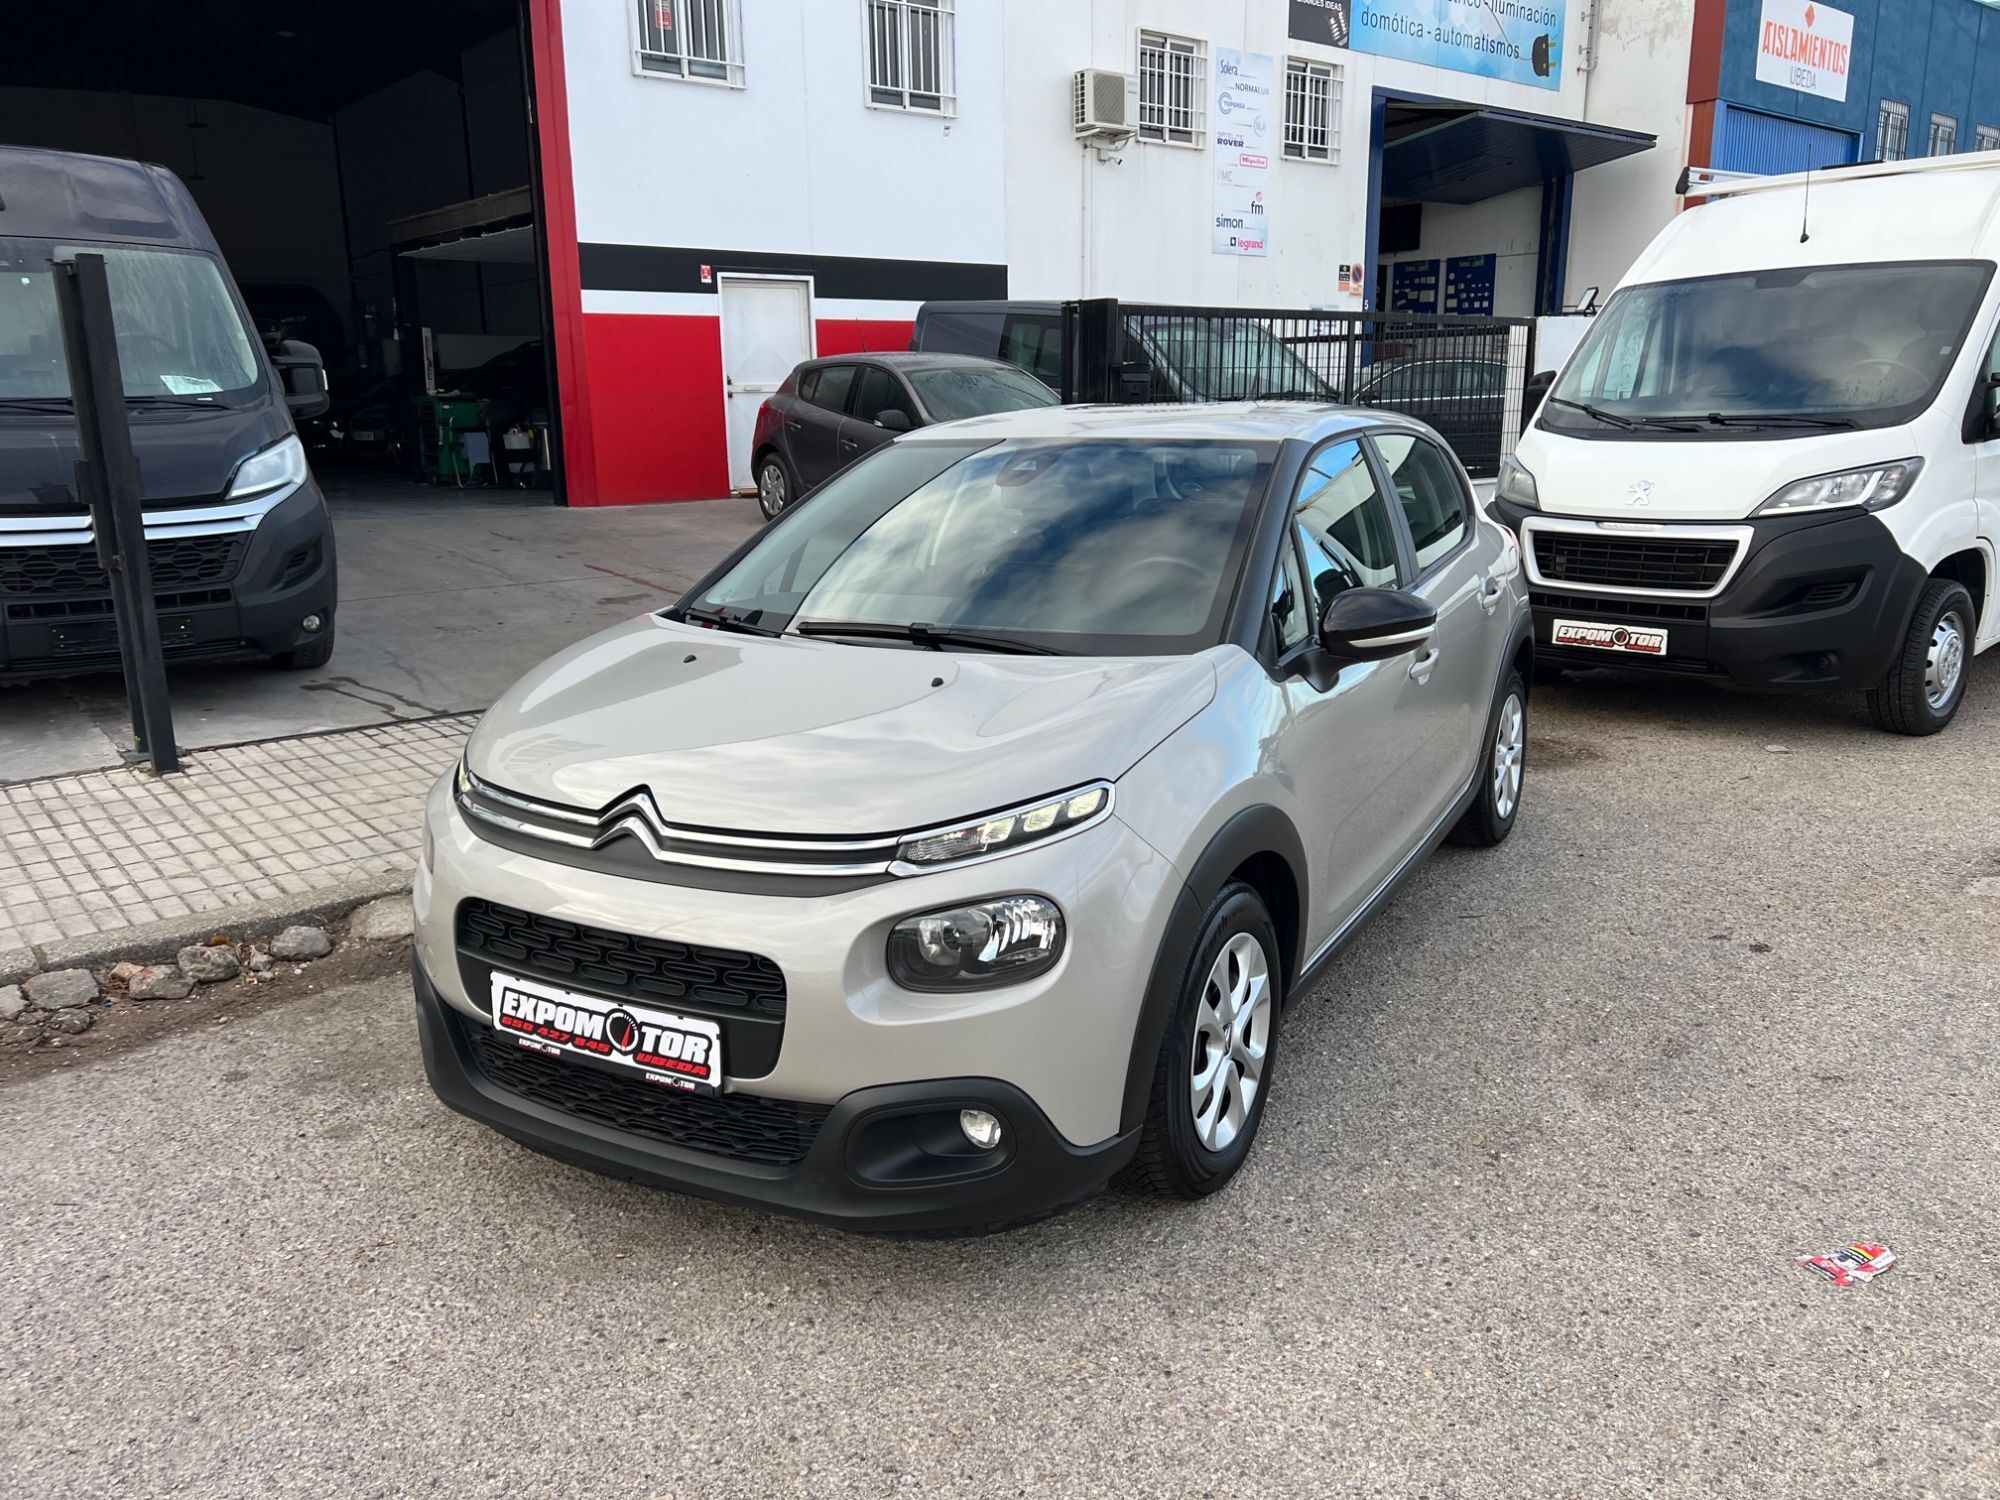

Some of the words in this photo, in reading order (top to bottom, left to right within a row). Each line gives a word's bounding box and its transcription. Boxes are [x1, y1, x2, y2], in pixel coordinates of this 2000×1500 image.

[1325, 0, 1342, 11] IDEAS
[1361, 6, 1423, 38] domótica
[1434, 27, 1520, 59] automatismos
[1762, 20, 1848, 76] AISLAMIENTOS
[1220, 59, 1238, 76] Solera
[1790, 66, 1816, 89] UBEDA
[1235, 82, 1270, 96] NORMALUX
[1217, 138, 1244, 148] ROVER
[1251, 201, 1263, 215] fm
[1216, 214, 1243, 229] simon
[1237, 237, 1263, 251] legrand
[1364, 300, 1369, 310] 5
